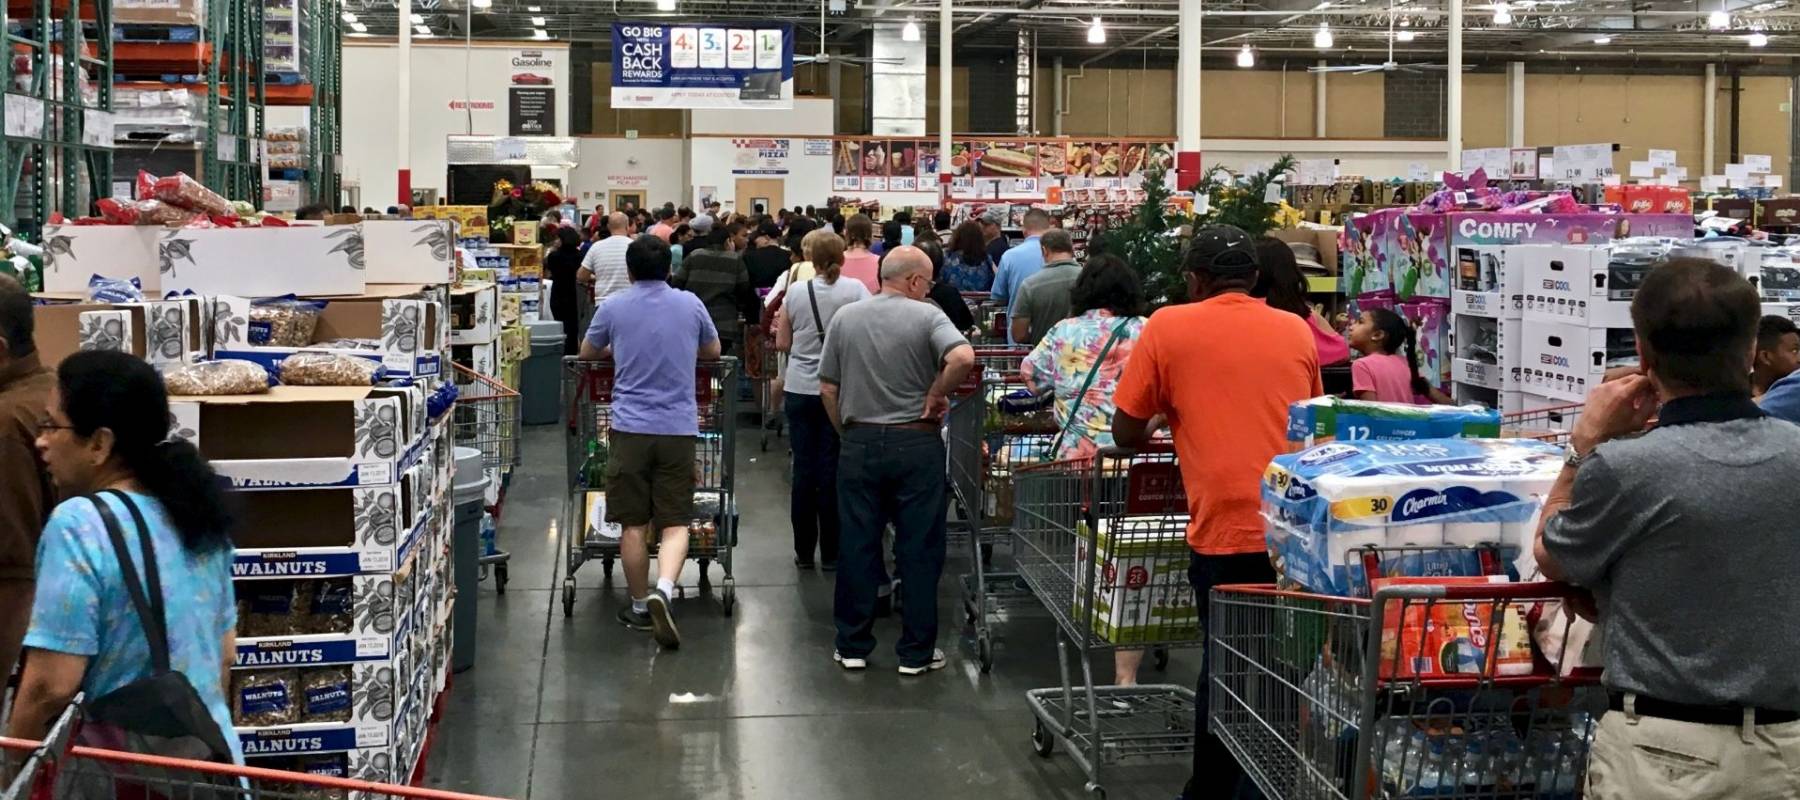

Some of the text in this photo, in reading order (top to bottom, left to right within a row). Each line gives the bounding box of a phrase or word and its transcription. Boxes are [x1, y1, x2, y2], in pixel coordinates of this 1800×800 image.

[622, 27, 662, 37] GO BIG
[622, 43, 662, 56] CASH
[512, 57, 552, 67] Gasoline
[622, 56, 662, 70] BACK
[622, 70, 663, 78] REWARDS
[1459, 218, 1537, 239] COMFY
[1348, 426, 1370, 440] 12
[1371, 498, 1387, 512] 30
[1402, 494, 1448, 516] Charmin
[232, 561, 326, 575] WALNUTS
[245, 690, 284, 700] WALNUTS
[241, 737, 322, 753] ALNUTS
